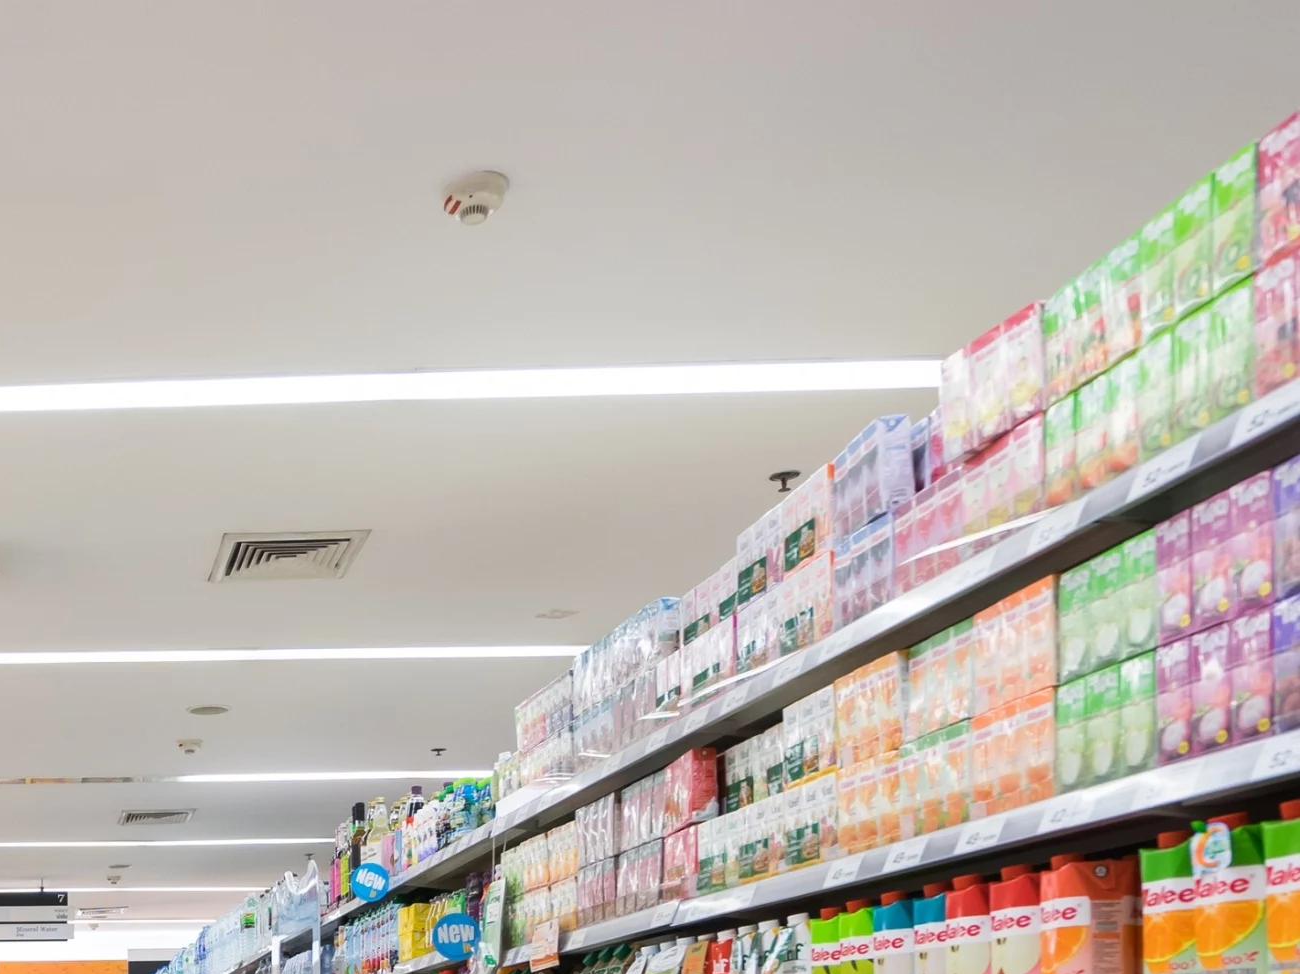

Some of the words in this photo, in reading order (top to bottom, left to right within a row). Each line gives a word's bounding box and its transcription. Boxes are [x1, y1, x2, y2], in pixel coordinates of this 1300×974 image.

[355, 868, 387, 890] New
[57, 894, 65, 903] 7
[437, 923, 475, 944] New
